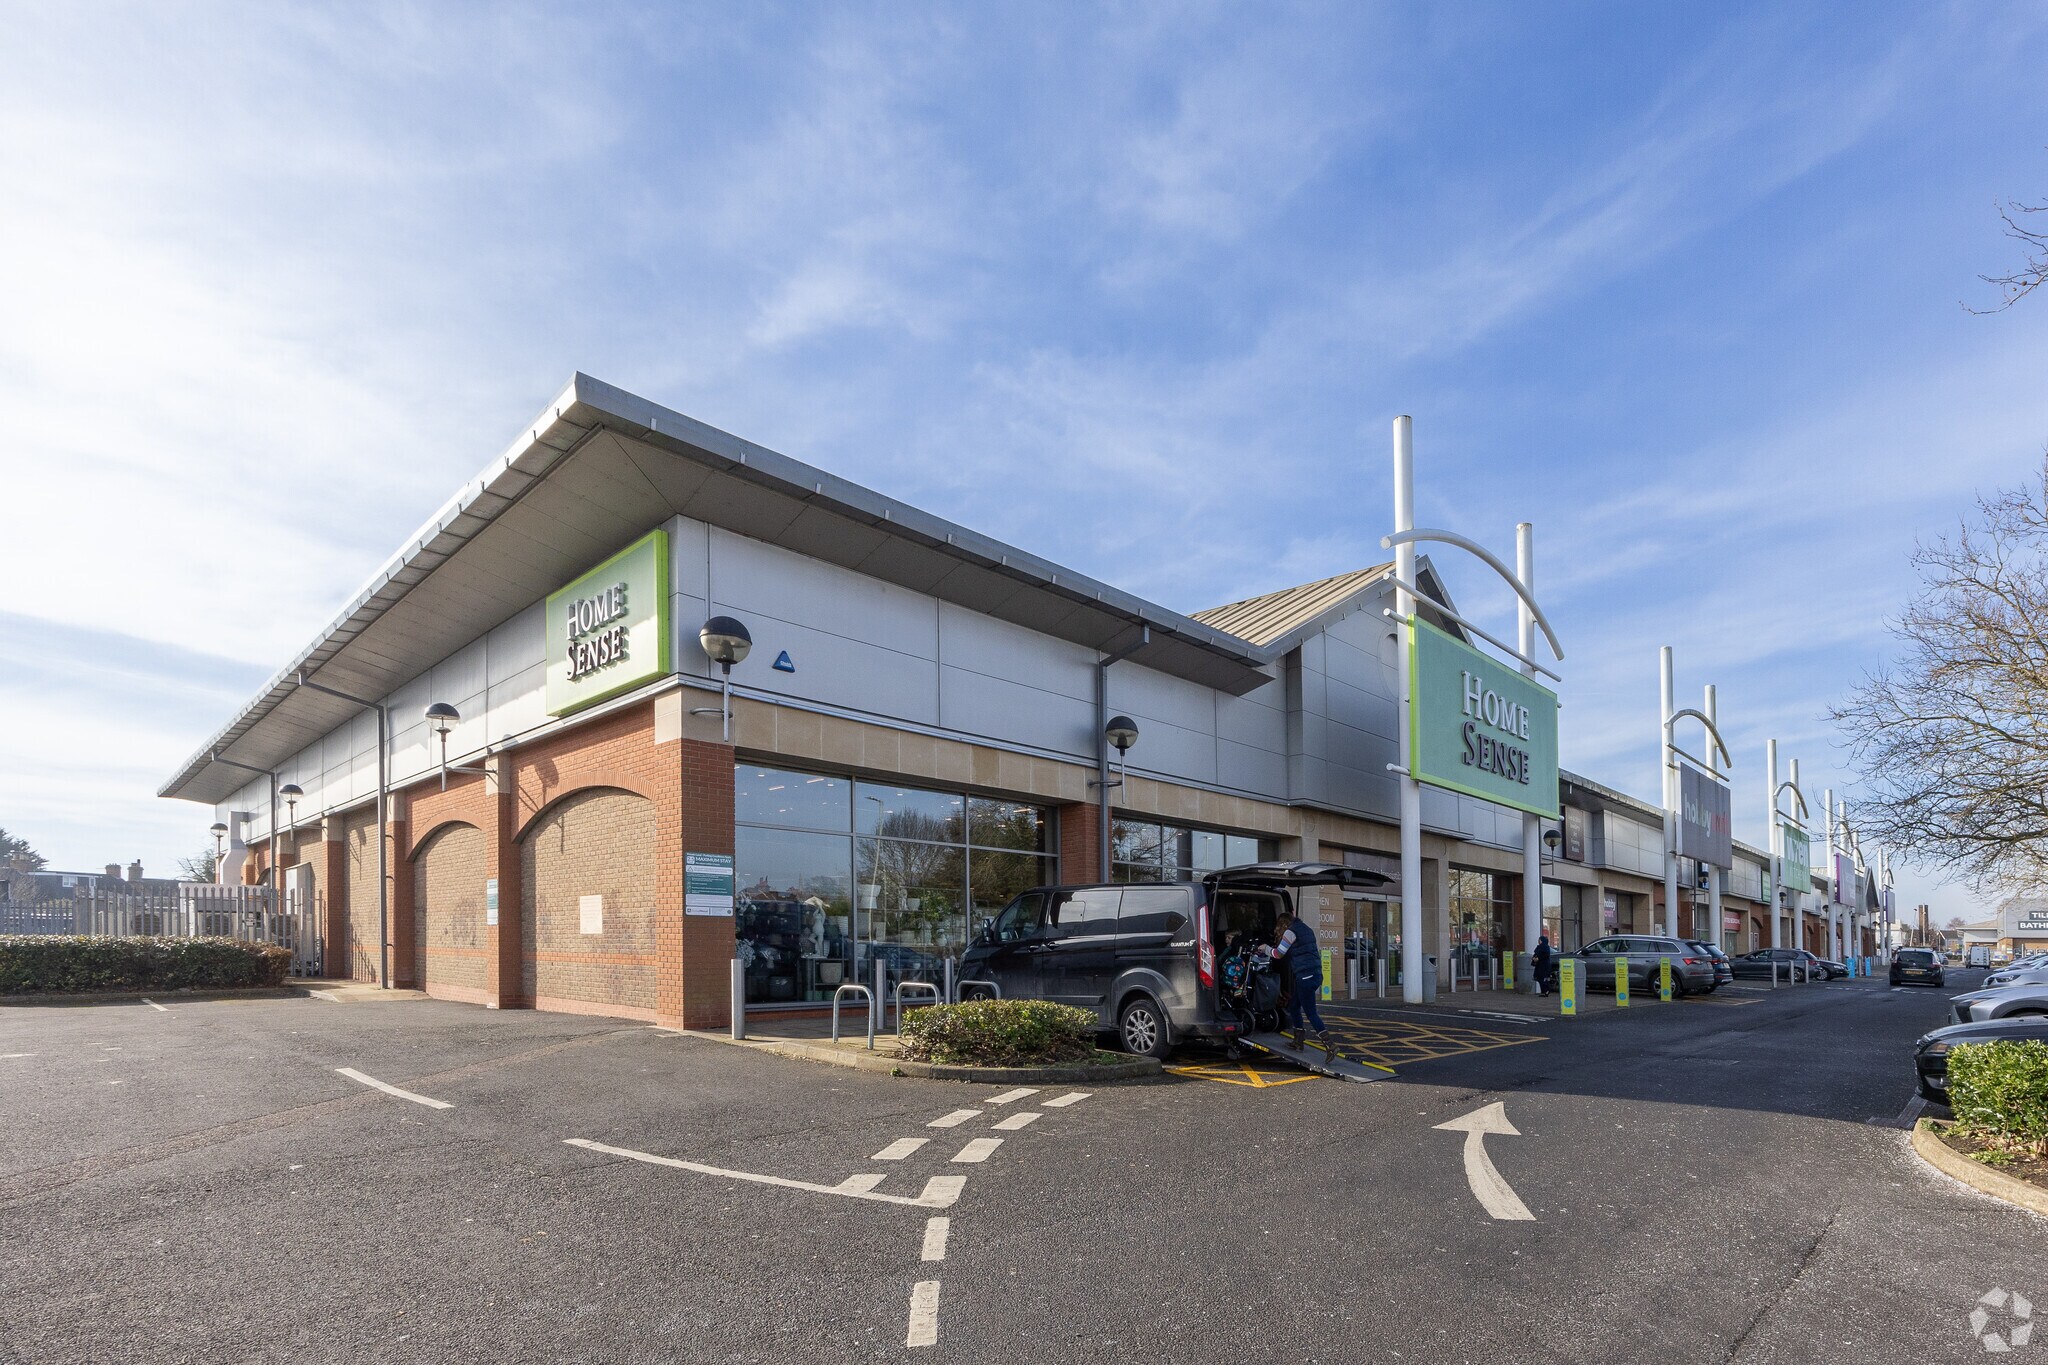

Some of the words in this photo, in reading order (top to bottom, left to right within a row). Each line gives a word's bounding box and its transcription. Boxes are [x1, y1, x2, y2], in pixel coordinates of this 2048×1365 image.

[566, 582, 626, 641] HOME
[566, 626, 625, 681] SENSE
[1462, 670, 1529, 740] HOME
[1462, 720, 1529, 785] SENSE
